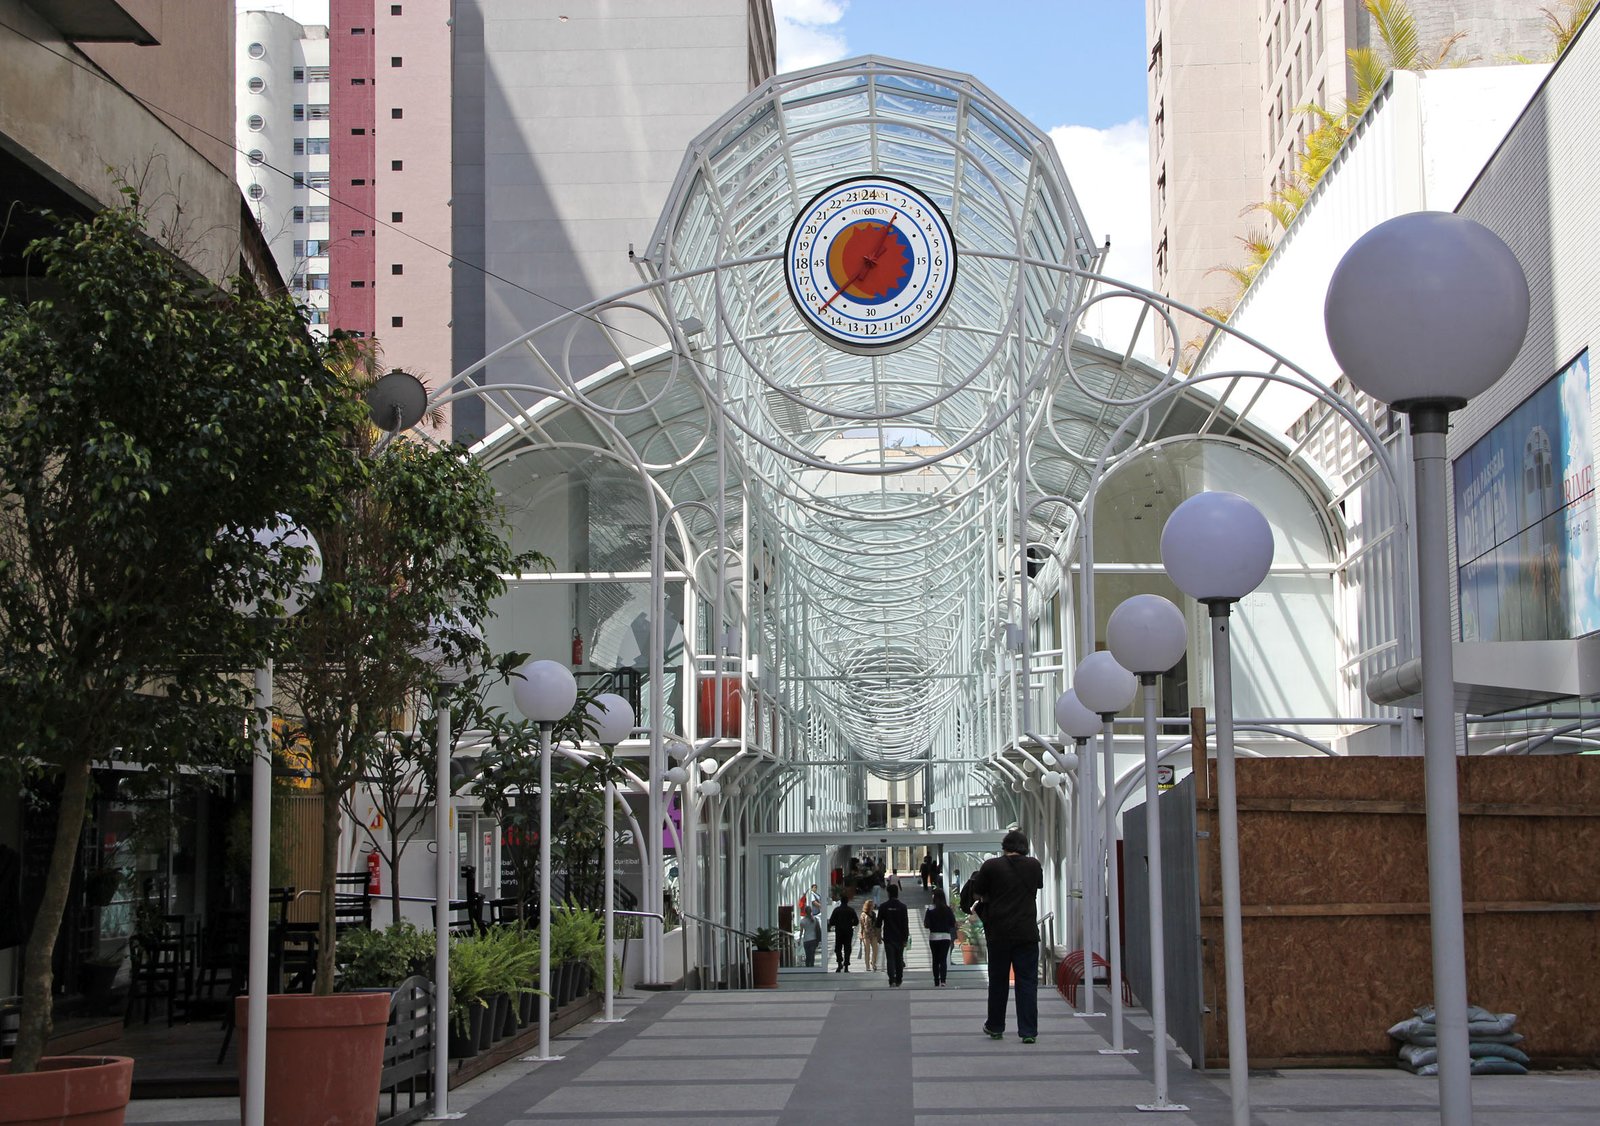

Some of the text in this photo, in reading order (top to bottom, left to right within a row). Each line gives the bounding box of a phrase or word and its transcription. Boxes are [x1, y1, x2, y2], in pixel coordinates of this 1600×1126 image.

[846, 193, 857, 202] 23
[862, 189, 877, 200] 24
[885, 192, 889, 202] 1
[830, 200, 842, 209] 22
[901, 199, 906, 207] 2
[817, 211, 827, 221] 21
[915, 209, 921, 218] 3
[805, 225, 817, 234] 20
[926, 223, 932, 231] 4
[800, 242, 809, 250] 19
[934, 239, 938, 248] 5
[796, 258, 808, 269] 18
[814, 259, 824, 267] 45
[917, 257, 926, 265] 15
[935, 256, 942, 266] 6
[799, 277, 809, 285] 17
[933, 274, 939, 282] 7
[805, 293, 816, 302] 16
[927, 290, 933, 299] 8
[817, 306, 828, 315] 15
[916, 304, 922, 312] 9
[831, 317, 842, 325] 14
[900, 315, 911, 324] 10
[848, 323, 858, 331] 13
[865, 324, 877, 335] 12
[884, 323, 893, 331] 11
